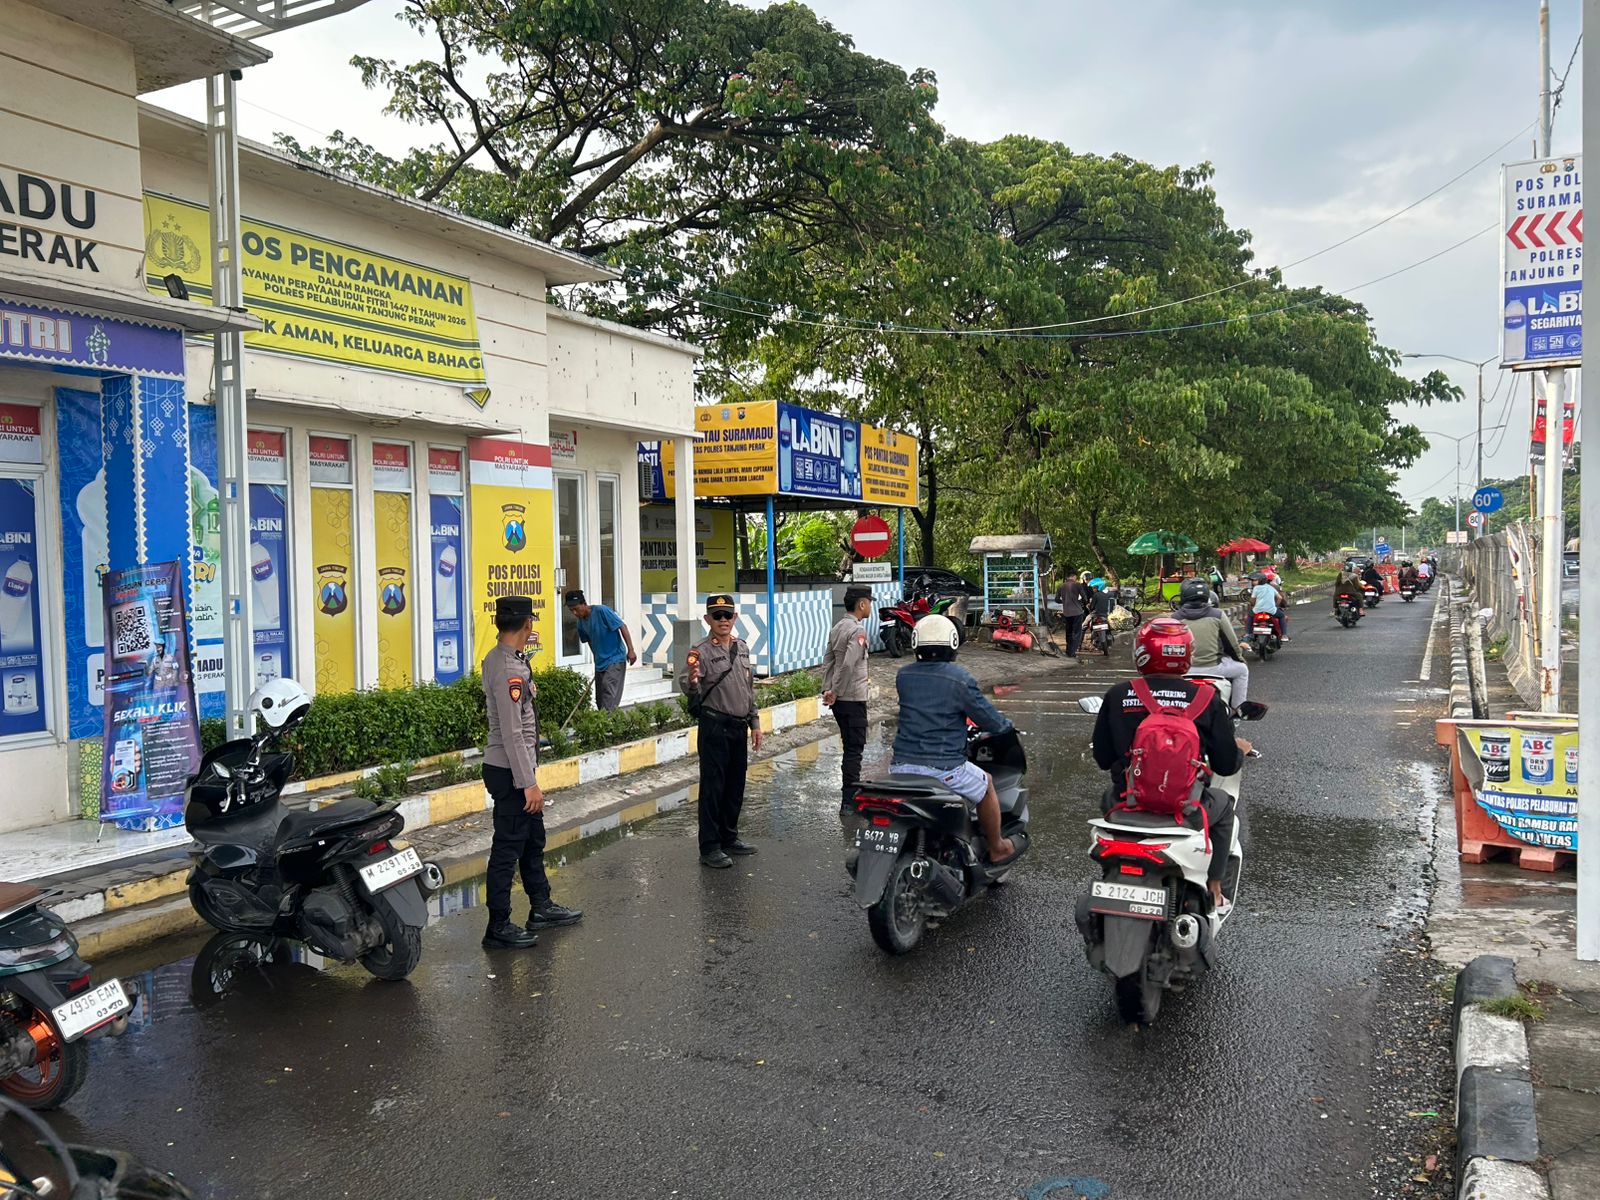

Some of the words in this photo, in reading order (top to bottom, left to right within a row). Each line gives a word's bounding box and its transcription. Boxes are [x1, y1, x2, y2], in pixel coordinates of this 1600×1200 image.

[1516, 177, 1544, 192] POS
[1554, 173, 1581, 187] POL
[1517, 191, 1581, 210] SURAMA
[1530, 247, 1582, 263] POLRES
[241, 231, 282, 261] OS
[290, 243, 463, 307] PENGAMANAN
[318, 275, 352, 291] DALAM
[354, 284, 391, 300] RANGKA
[264, 283, 304, 299] POLRES
[307, 292, 364, 312] PELABUHAN
[366, 305, 406, 321] TANJUNG
[408, 315, 436, 328] PERAK
[288, 278, 341, 297] PERAYAAN
[343, 291, 364, 303] IDUL
[367, 296, 388, 308] FITRI
[390, 301, 408, 313] 1447
[418, 308, 446, 321] TAHUN
[447, 315, 466, 326] 2026
[1530, 315, 1582, 330] SEGARNYA
[282, 322, 339, 350] AMAN,
[343, 335, 424, 362] KELUARGA
[6, 425, 34, 433] UNTUK
[722, 427, 773, 441] SURAMADU
[791, 417, 841, 458] LABINI
[703, 444, 723, 453] POLRES
[724, 443, 748, 452] TANJUNG
[748, 443, 765, 451] PERAK
[1475, 493, 1491, 507] 60
[431, 525, 459, 536] LABINI
[488, 564, 508, 580] POS
[510, 564, 540, 579] POLISI
[487, 580, 542, 597] SURAMADU
[114, 706, 154, 722] SEKALI
[158, 701, 187, 713] KLIK
[1482, 744, 1507, 754] ABC
[1522, 739, 1552, 750] ABC
[1505, 797, 1529, 810] POLRES
[1530, 799, 1567, 813] PELABUHAN
[376, 857, 401, 873] 2291
[400, 850, 414, 862] YE
[1095, 884, 1102, 895] S
[1108, 886, 1135, 899] 2124
[1142, 890, 1164, 904] JCH
[57, 1009, 67, 1021] S
[70, 994, 96, 1015] 4936
[96, 982, 119, 1001] EAM
